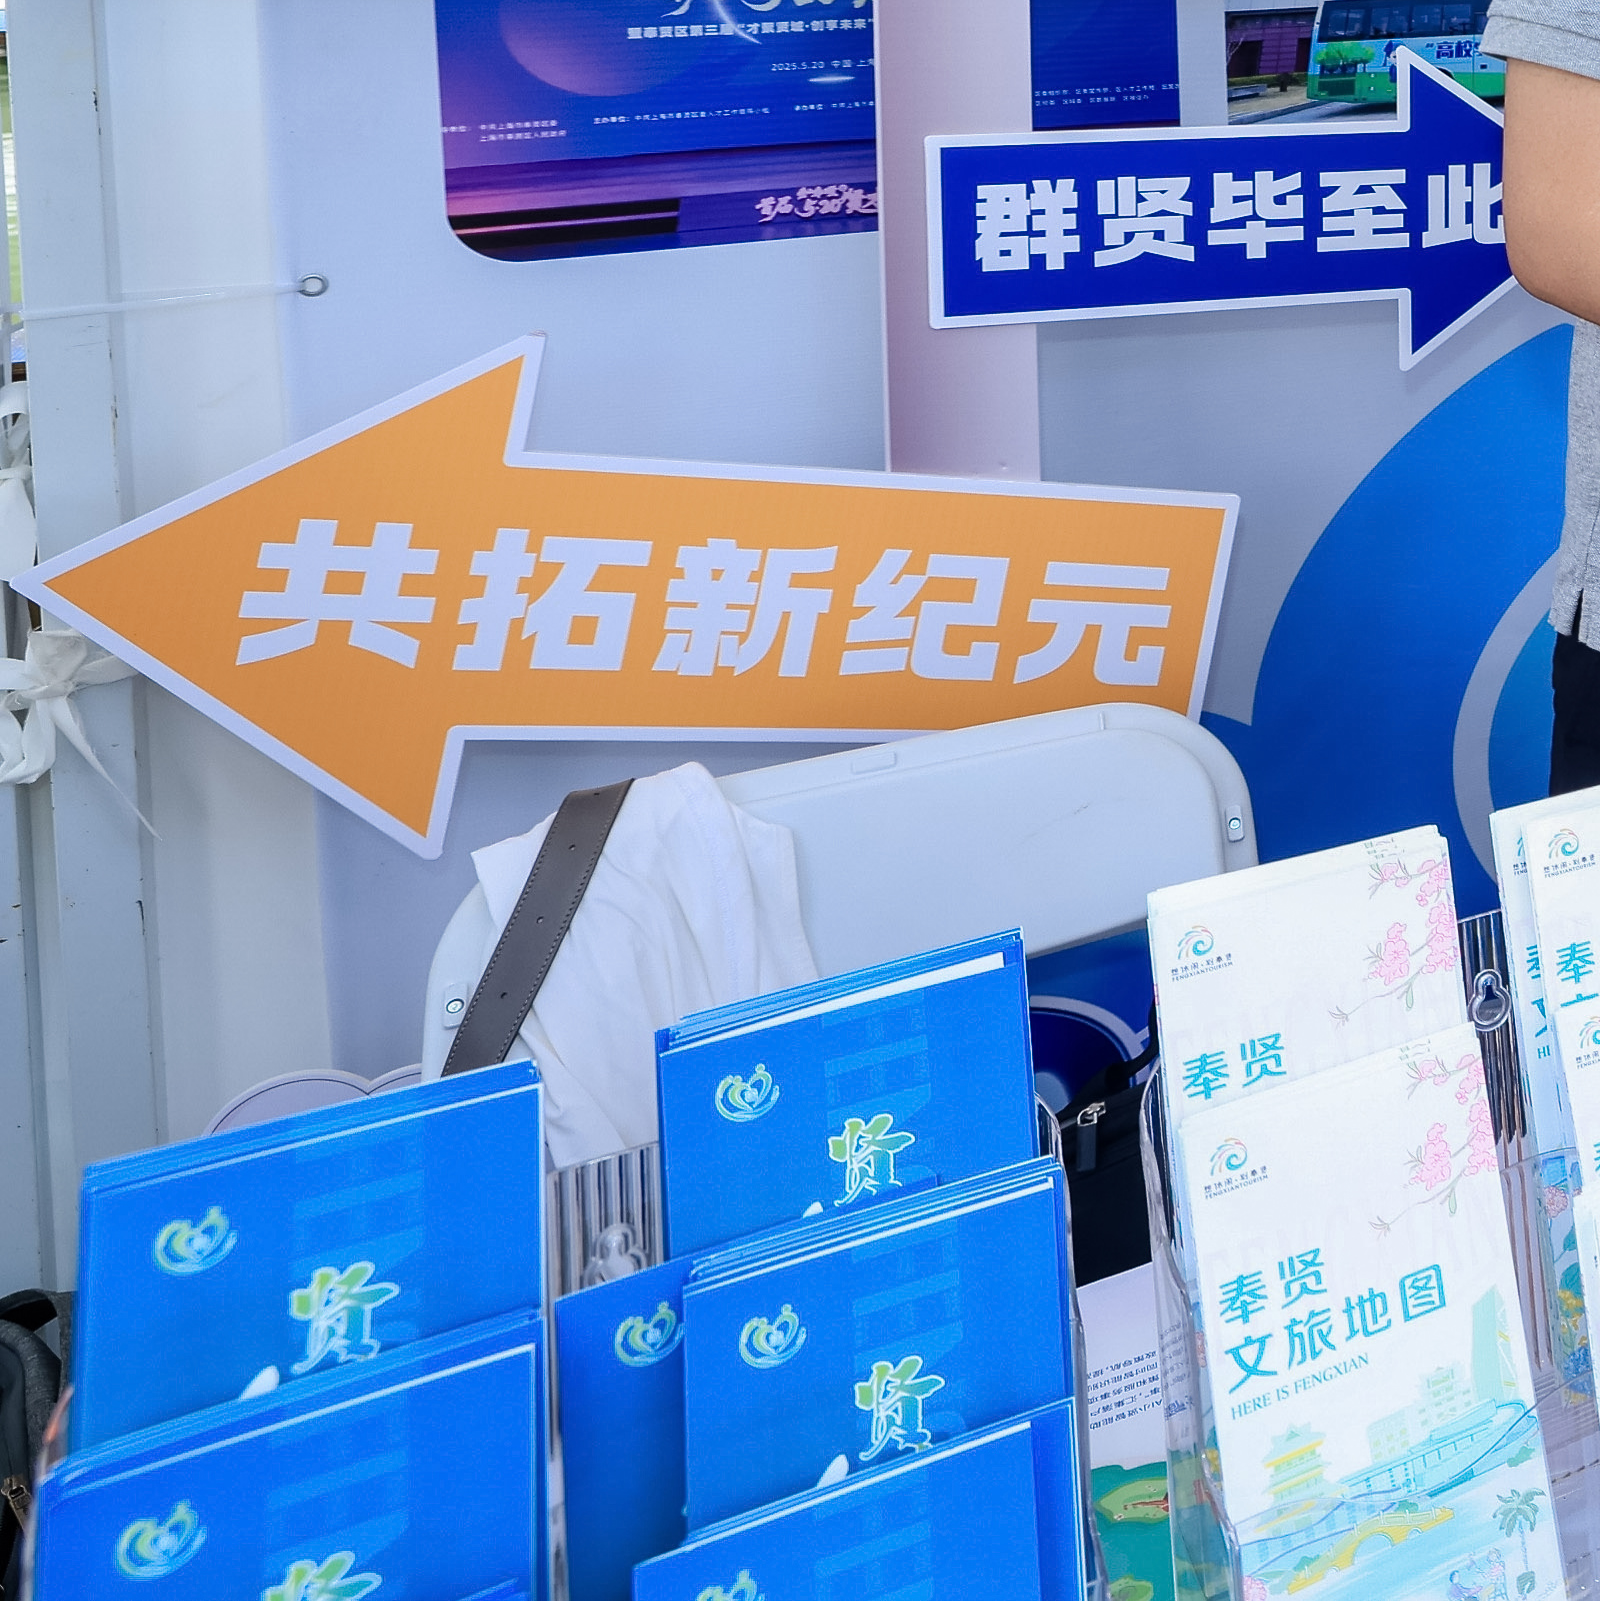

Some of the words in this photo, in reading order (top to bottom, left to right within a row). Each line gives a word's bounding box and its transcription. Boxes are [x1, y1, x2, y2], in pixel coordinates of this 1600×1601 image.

[770, 61, 826, 72] 2025.5.20
[975, 162, 1505, 272] 群贤毕至此
[235, 517, 1174, 687] 共拓新纪元
[1182, 1032, 1287, 1100] 奉贤
[1219, 1247, 1328, 1325] 奉贤
[1224, 1263, 1447, 1395] 文旅地图
[1230, 1390, 1272, 1420] HERE
[1276, 1384, 1290, 1402] IS
[1294, 1351, 1370, 1394] FENGXIAN
